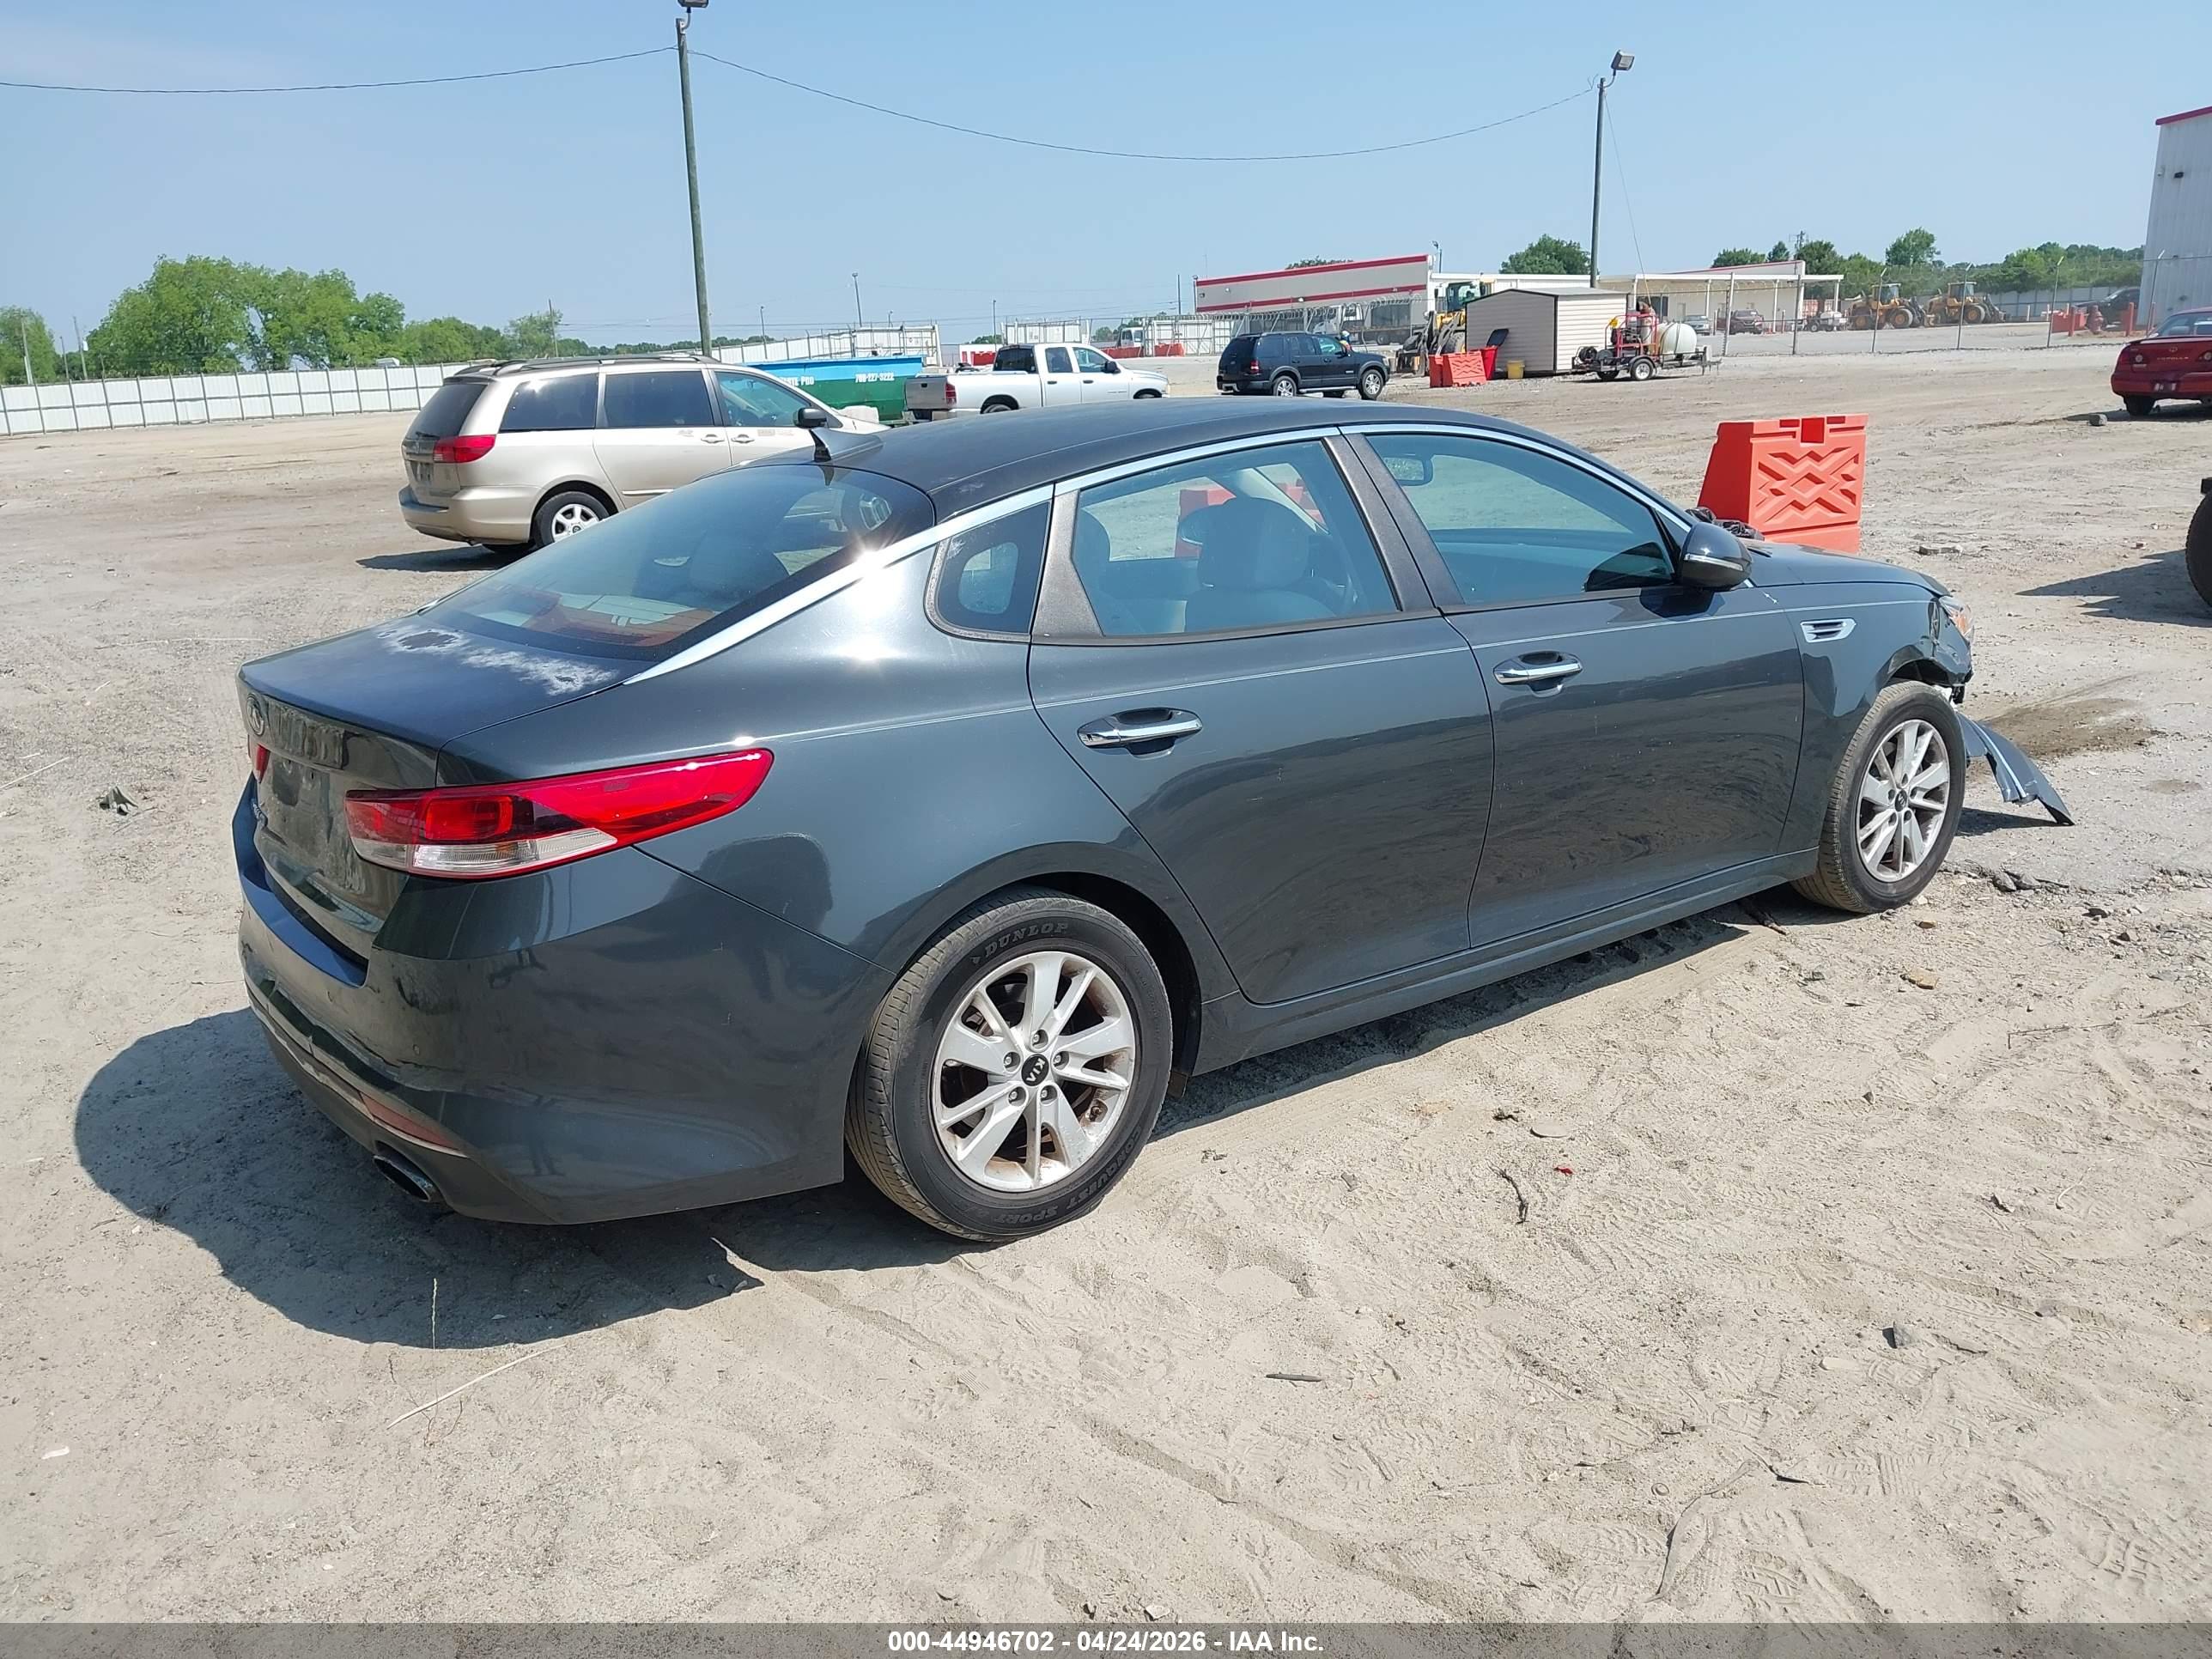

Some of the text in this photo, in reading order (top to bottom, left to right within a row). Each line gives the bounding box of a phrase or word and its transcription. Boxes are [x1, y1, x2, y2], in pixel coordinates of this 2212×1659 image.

[984, 921, 1068, 957] DUNLOP
[1026, 1057, 1046, 1081] KIA
[1066, 1124, 1144, 1210] CONQUEST
[992, 1205, 1059, 1224] SPORT
